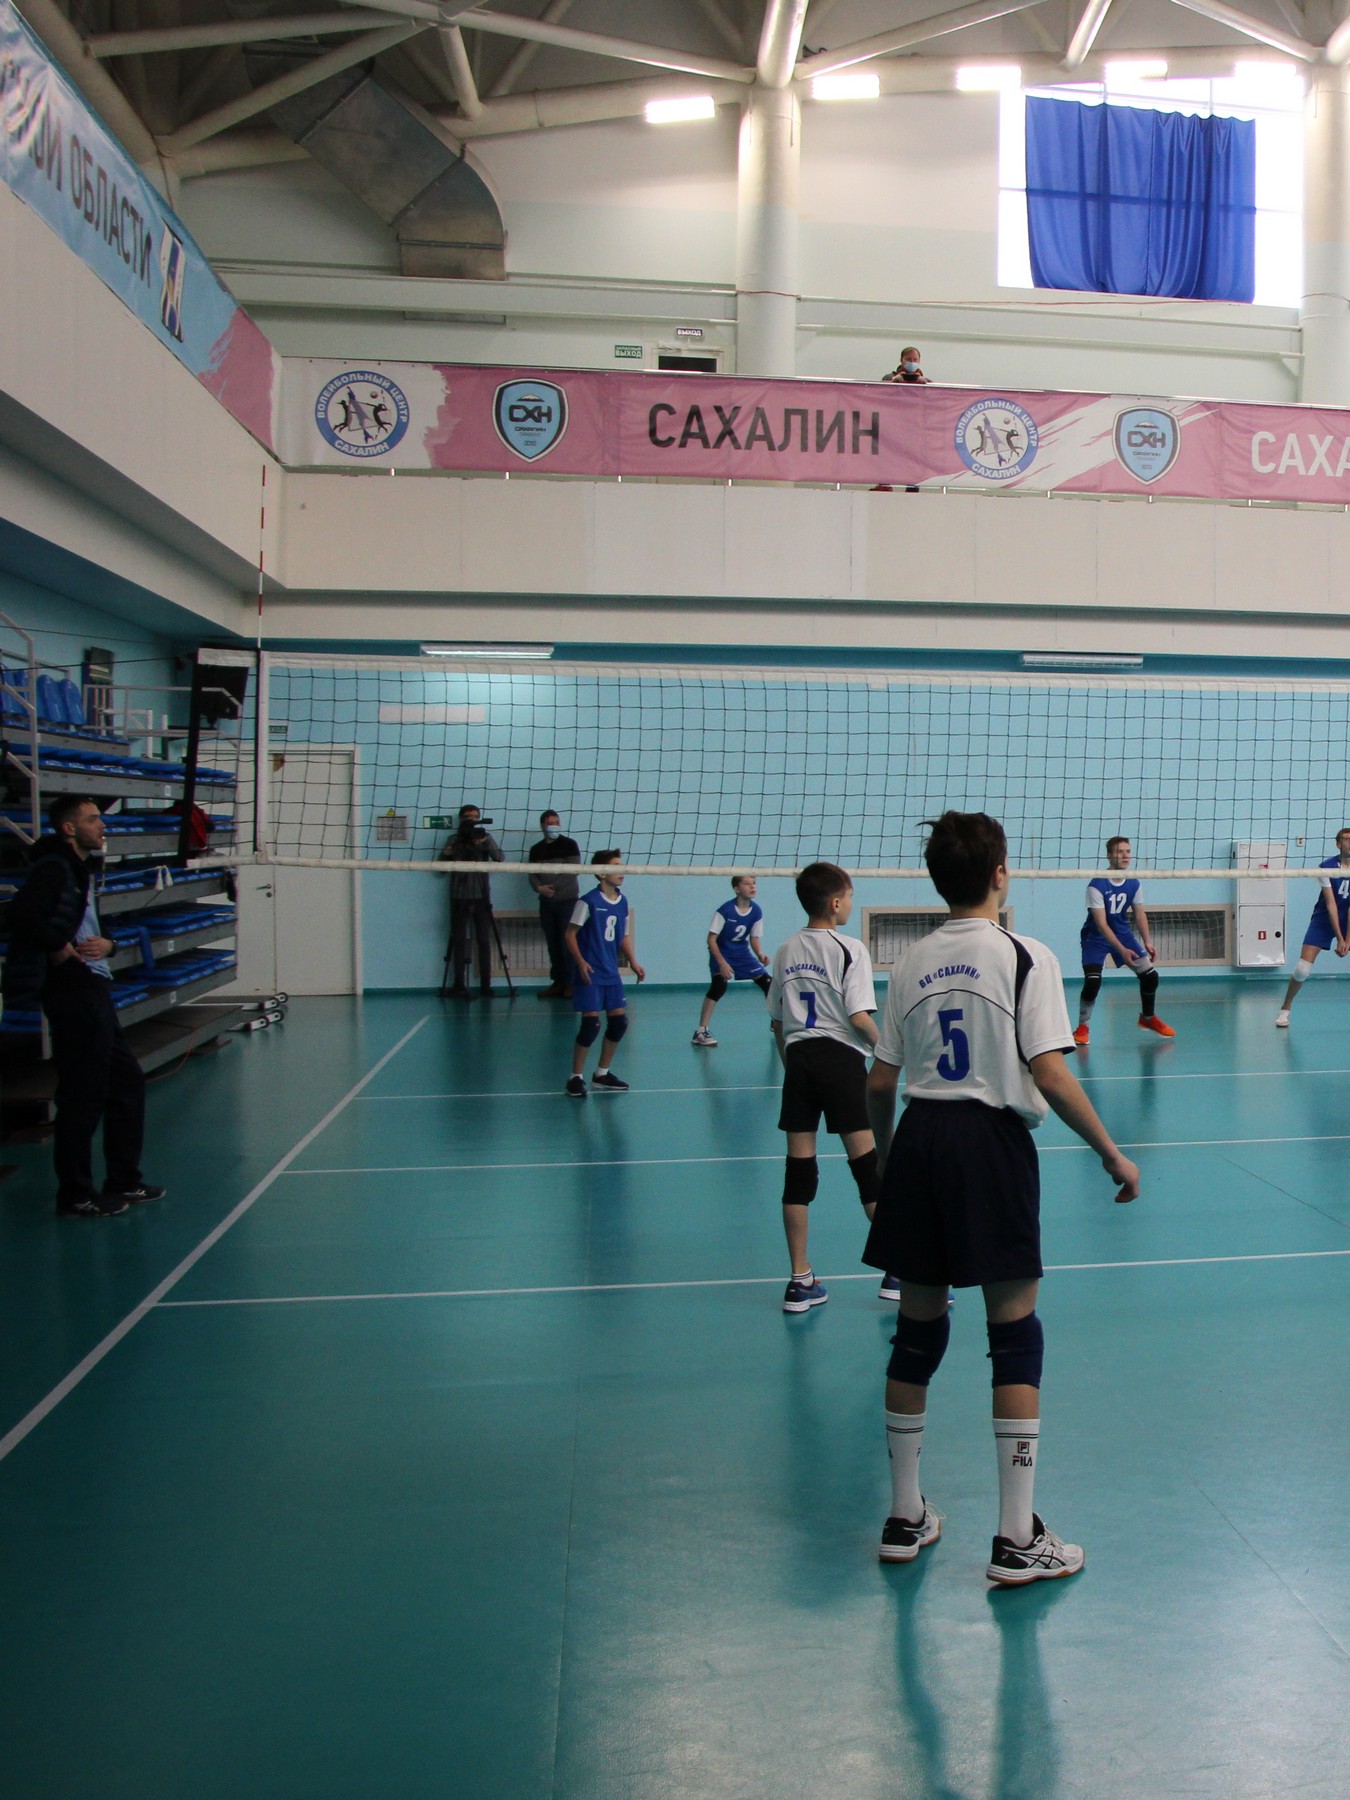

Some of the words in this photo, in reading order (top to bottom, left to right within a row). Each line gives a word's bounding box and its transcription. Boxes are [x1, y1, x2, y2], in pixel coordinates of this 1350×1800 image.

[70, 134, 152, 289] ОБЛАСТИ
[615, 350, 641, 358] ВЫХОД
[317, 373, 390, 418] ВОЛЕЙБОЛЬНЫЙ
[390, 387, 408, 423] ЦЕНТР
[648, 402, 881, 456] САХАЛИН
[956, 401, 1022, 443] ВОЛЕЙБОЛЬНЫЙ
[1021, 414, 1037, 447] ЦЕНТР
[334, 440, 389, 456] САХАЛИН
[972, 463, 1021, 478] САХАЛИН
[1338, 879, 1350, 899] 4
[1109, 892, 1128, 914] 12
[604, 915, 618, 941] 8
[731, 924, 748, 941] 2
[919, 974, 933, 989] ВЦ
[800, 991, 818, 1028] 7
[936, 1008, 970, 1081] 5
[1012, 1455, 1033, 1467] FILA
